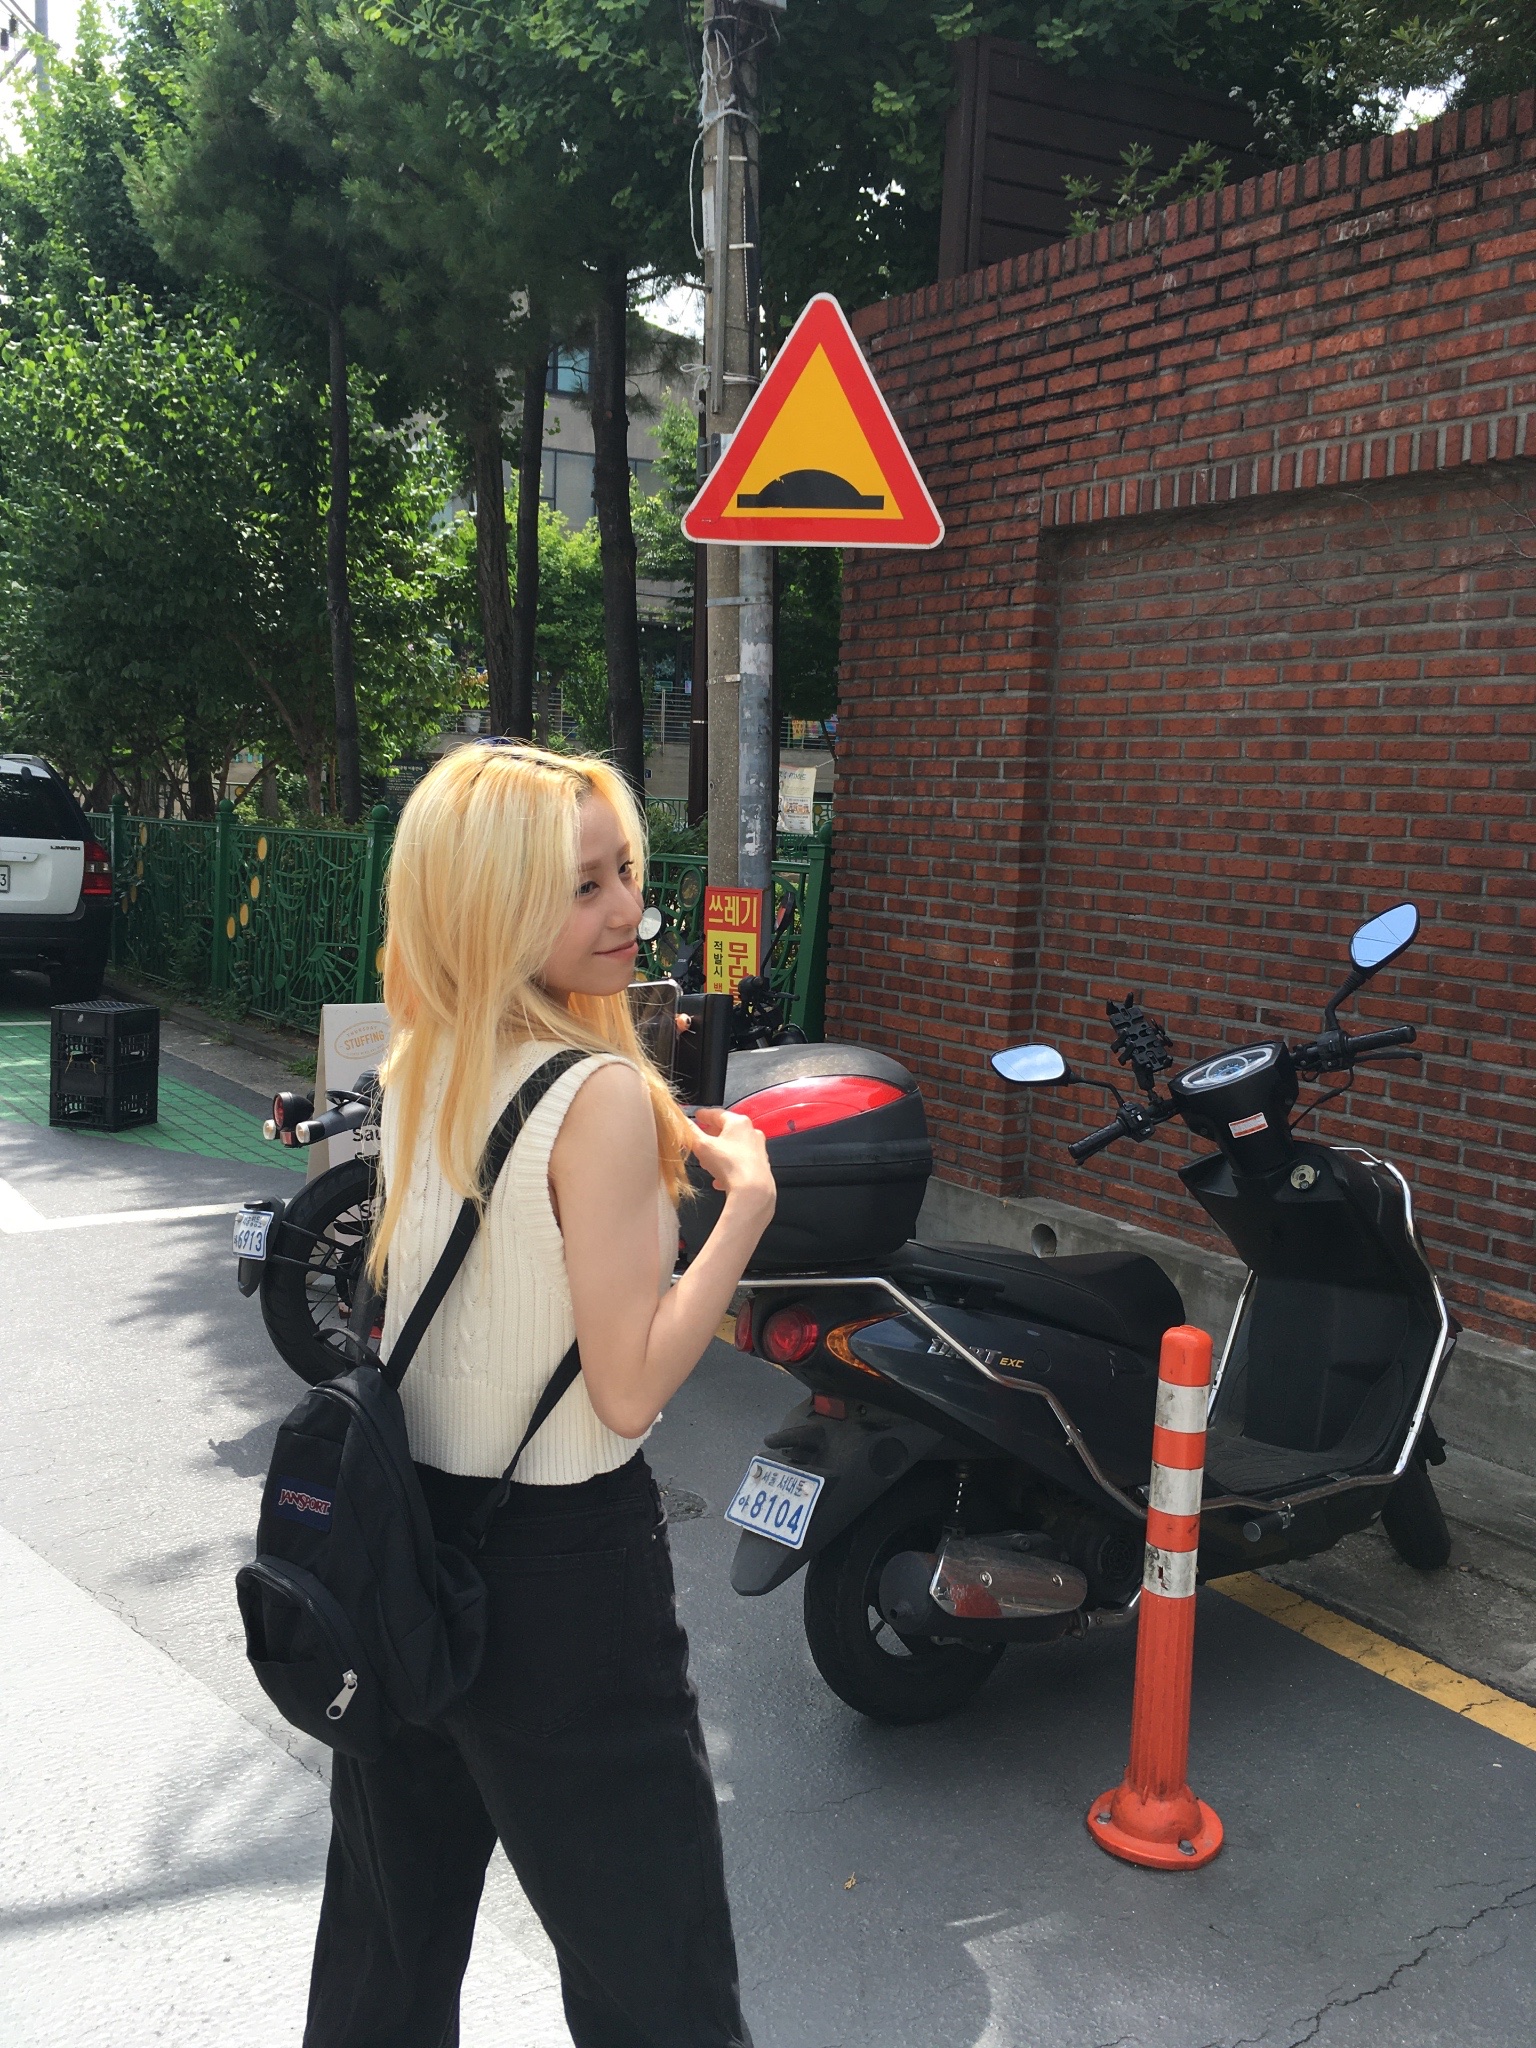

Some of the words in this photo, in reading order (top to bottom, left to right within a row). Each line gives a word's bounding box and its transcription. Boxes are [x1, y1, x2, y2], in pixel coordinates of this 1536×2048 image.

[708, 894, 758, 928] 쓰레기
[713, 940, 723, 978] 적발시
[344, 1030, 385, 1051] STUFFING
[237, 1229, 264, 1252] 6913
[999, 1357, 1025, 1369] EXC
[761, 1471, 778, 1488] 서울
[278, 1488, 332, 1516] JANSPORT
[750, 1490, 804, 1535] 8104
